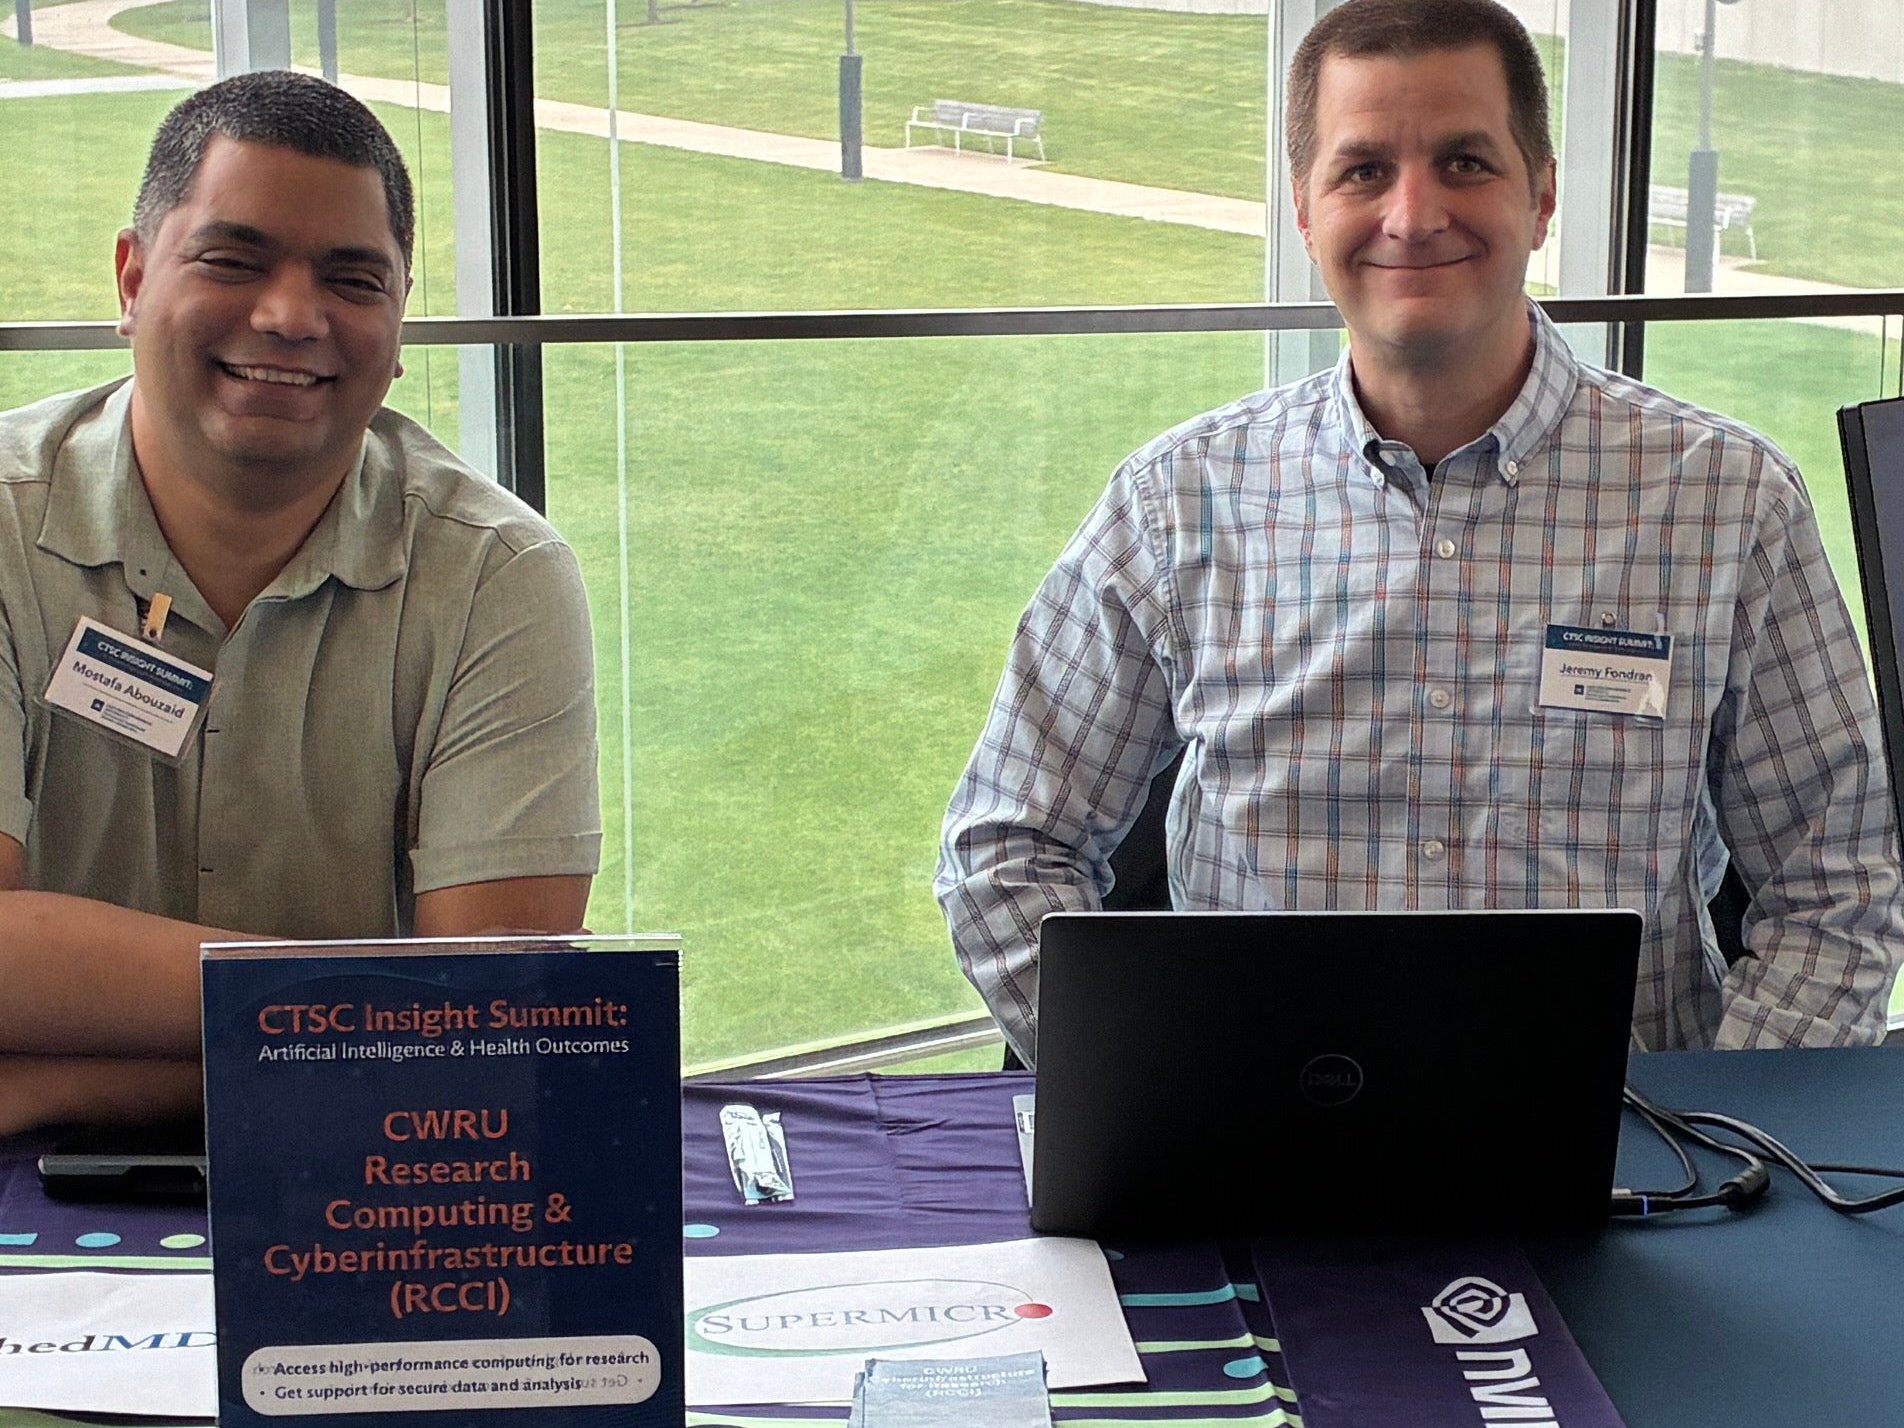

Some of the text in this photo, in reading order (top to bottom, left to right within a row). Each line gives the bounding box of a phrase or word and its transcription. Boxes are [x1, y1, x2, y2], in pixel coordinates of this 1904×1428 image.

[1560, 663, 1603, 679] Jeremy
[72, 661, 122, 691] Mostafa
[124, 685, 186, 719] Abouzaid
[258, 997, 628, 1038] CTSC Insight Summit:
[258, 1036, 629, 1062] Artificial Intelligence & Health Outcomes
[383, 1109, 509, 1141] CWRU
[364, 1152, 530, 1185] Research
[324, 1192, 572, 1235] Computing &
[263, 1240, 633, 1280] Cyberinfrastructure
[390, 1277, 511, 1318] (RCCI)
[273, 1351, 650, 1379] Access high-performance computing for research
[274, 1385, 302, 1400] Get
[307, 1383, 369, 1400] support
[371, 1382, 396, 1395] for
[398, 1382, 448, 1395] secure
[451, 1380, 488, 1393] data
[491, 1379, 520, 1392] and
[523, 1377, 583, 1393] analysis
